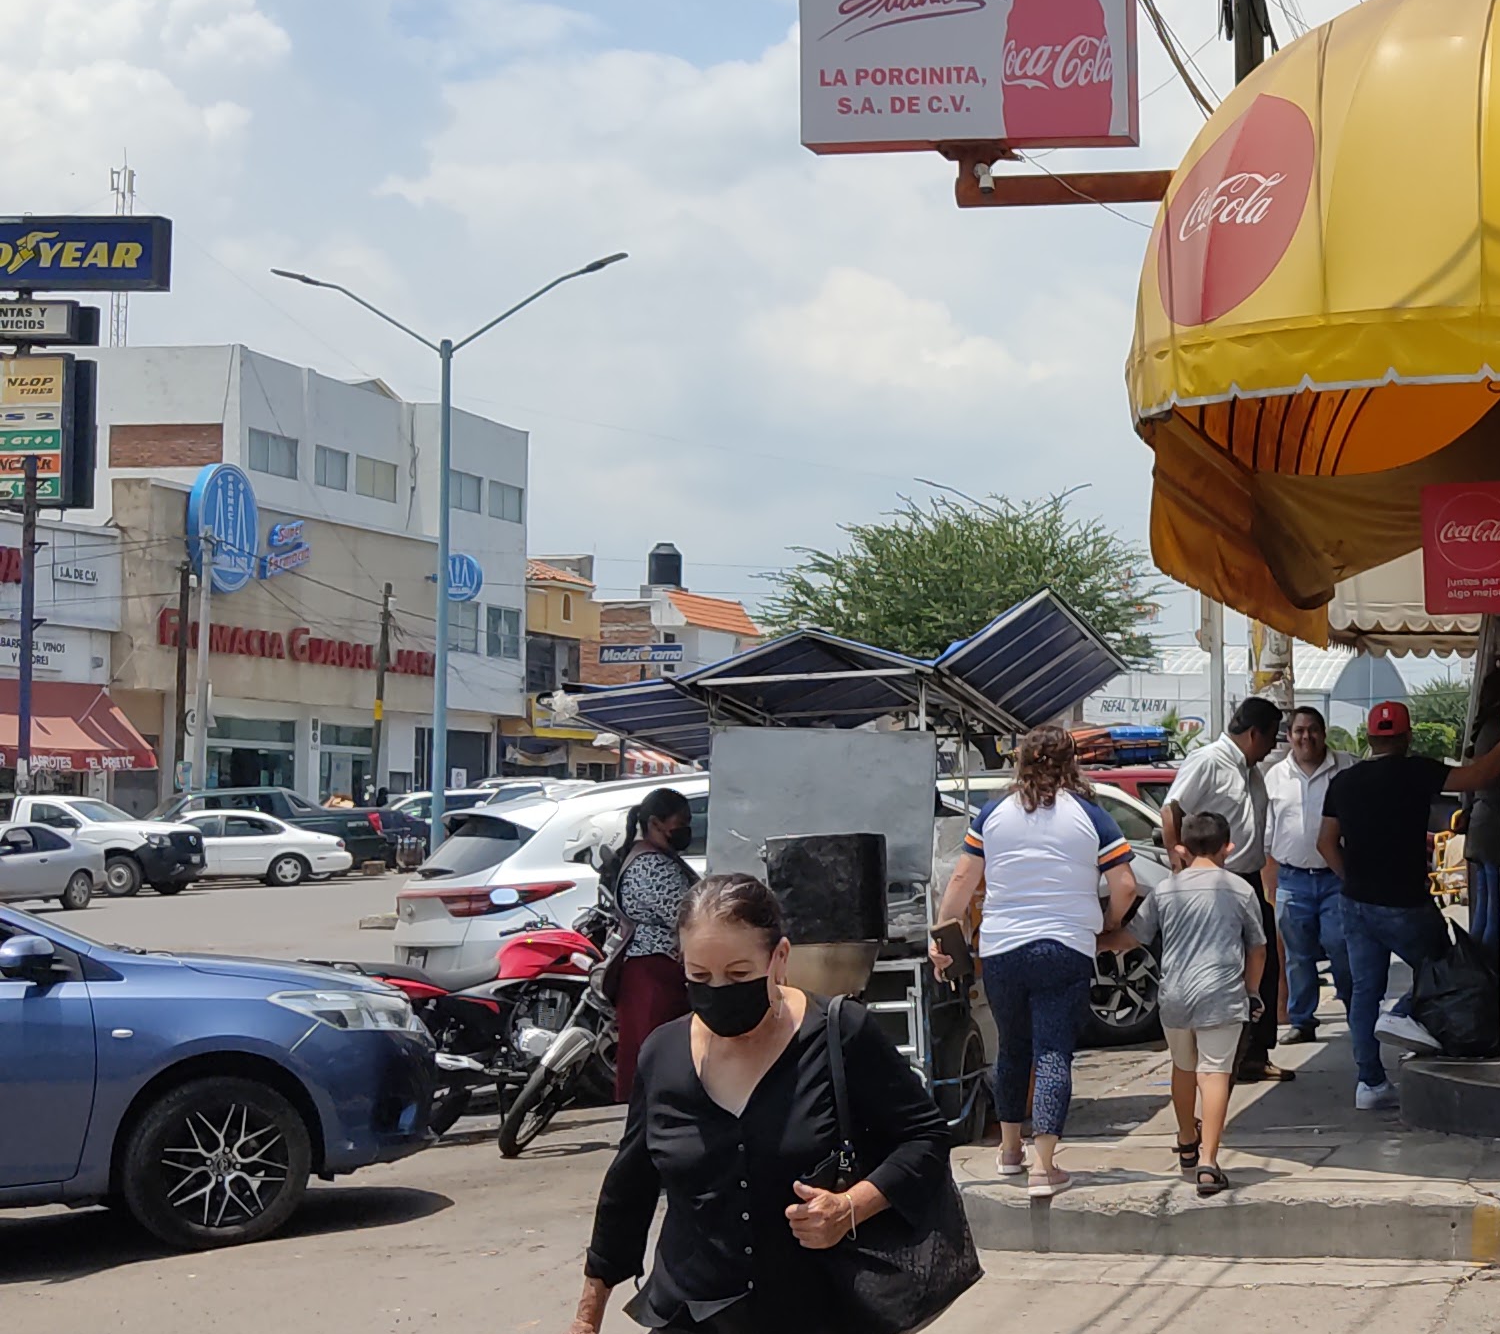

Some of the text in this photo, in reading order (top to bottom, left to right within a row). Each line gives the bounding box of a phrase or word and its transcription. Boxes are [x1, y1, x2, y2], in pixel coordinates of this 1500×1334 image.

[1002, 34, 1113, 90] Coca-Cola
[819, 66, 987, 87] LA PORCINITA,
[837, 94, 971, 115] S.A. DE C.V.
[39, 307, 48, 318] Y
[73, 568, 83, 580] DE
